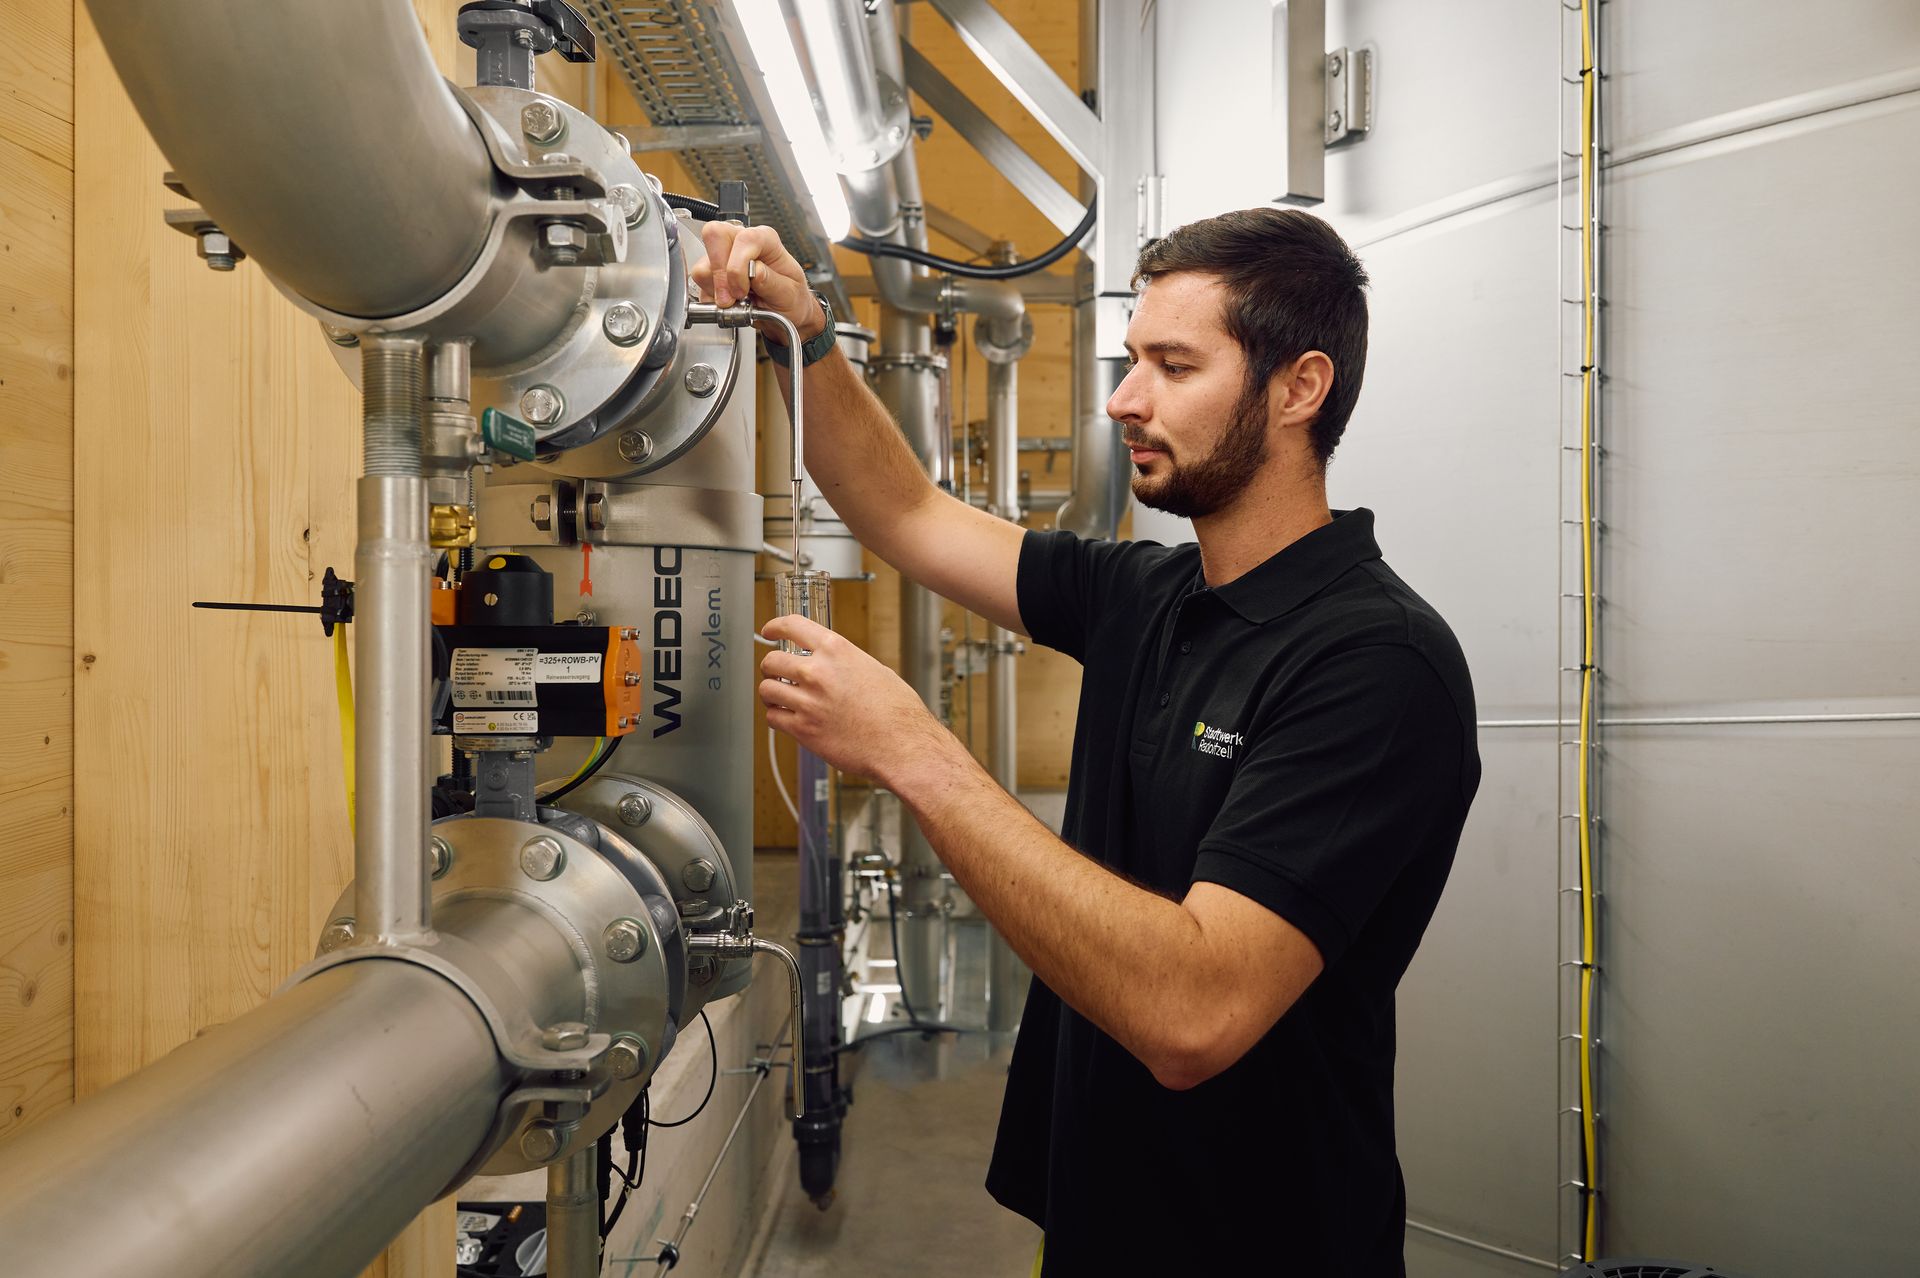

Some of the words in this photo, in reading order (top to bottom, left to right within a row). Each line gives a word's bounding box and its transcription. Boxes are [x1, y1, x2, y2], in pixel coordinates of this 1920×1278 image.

[702, 588, 726, 669] xylem
[539, 656, 599, 664] =325+ROWB-PV
[708, 677, 721, 691] a
[1203, 726, 1244, 746] Stadtwerk
